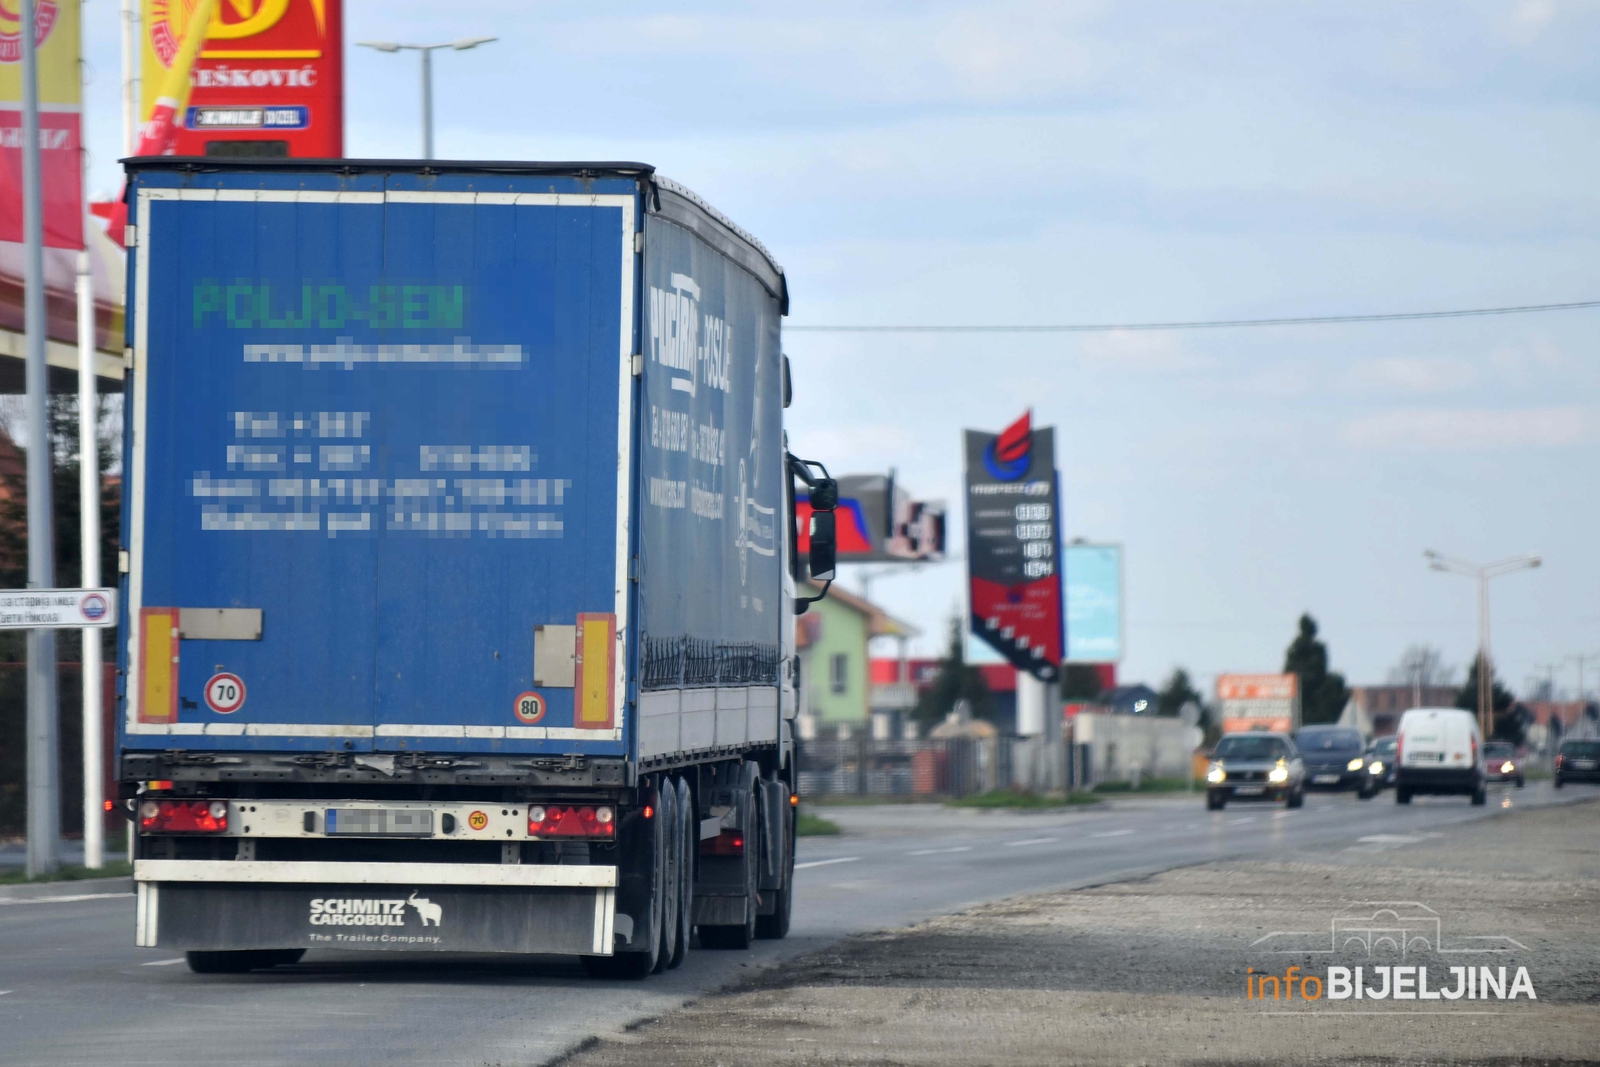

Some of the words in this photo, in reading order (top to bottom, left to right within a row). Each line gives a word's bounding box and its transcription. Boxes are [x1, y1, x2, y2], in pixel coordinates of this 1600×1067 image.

[190, 64, 317, 87] EŠKOVIĆ
[0, 612, 22, 623] вети
[25, 611, 60, 623] Никола
[217, 685, 235, 701] 70
[520, 699, 538, 716] 80
[472, 816, 485, 825] 70
[309, 898, 405, 915] SCHMITZ
[309, 914, 405, 926] CARGOBULL
[309, 934, 333, 942] The
